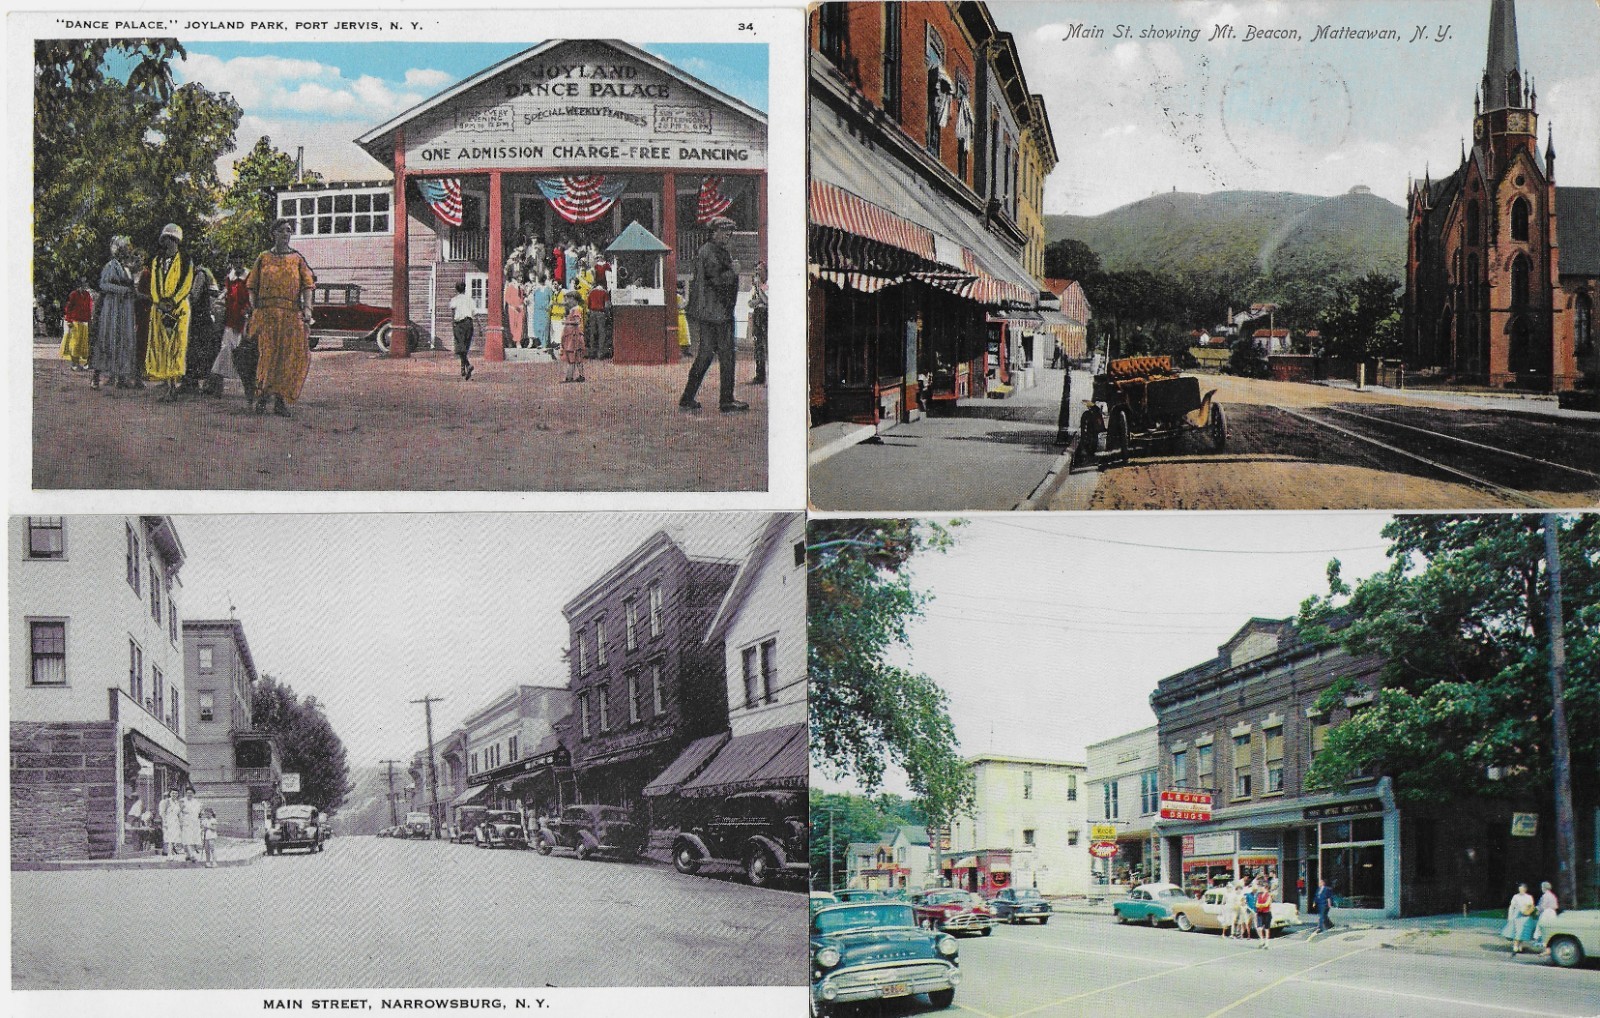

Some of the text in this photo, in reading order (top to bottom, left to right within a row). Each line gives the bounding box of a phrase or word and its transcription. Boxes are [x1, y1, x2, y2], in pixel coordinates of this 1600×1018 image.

[56, 18, 109, 30] "DANCE
[184, 21, 245, 30] JOYLAND
[250, 21, 288, 31] PARK,
[295, 21, 329, 30] PORT
[333, 21, 383, 31] JERVIS,
[390, 21, 403, 30] N.
[410, 21, 423, 30] Y.
[1062, 23, 1452, 43] Main St. showing Mt. Beacon, Matteawan, N. Y.
[531, 64, 638, 80] JOYLAND
[505, 83, 670, 98] DANCE PALACE
[524, 107, 565, 125] SPECIAL
[565, 105, 603, 117] WEEKLY
[422, 147, 450, 161] ONE
[457, 146, 544, 159] ADMISSION
[678, 147, 748, 161] DANCING
[1167, 793, 1206, 803] LEONS
[1169, 811, 1203, 820] DRUGS
[263, 998, 550, 1011] MAIN STREET, NARROWSBURG, N. Y.
